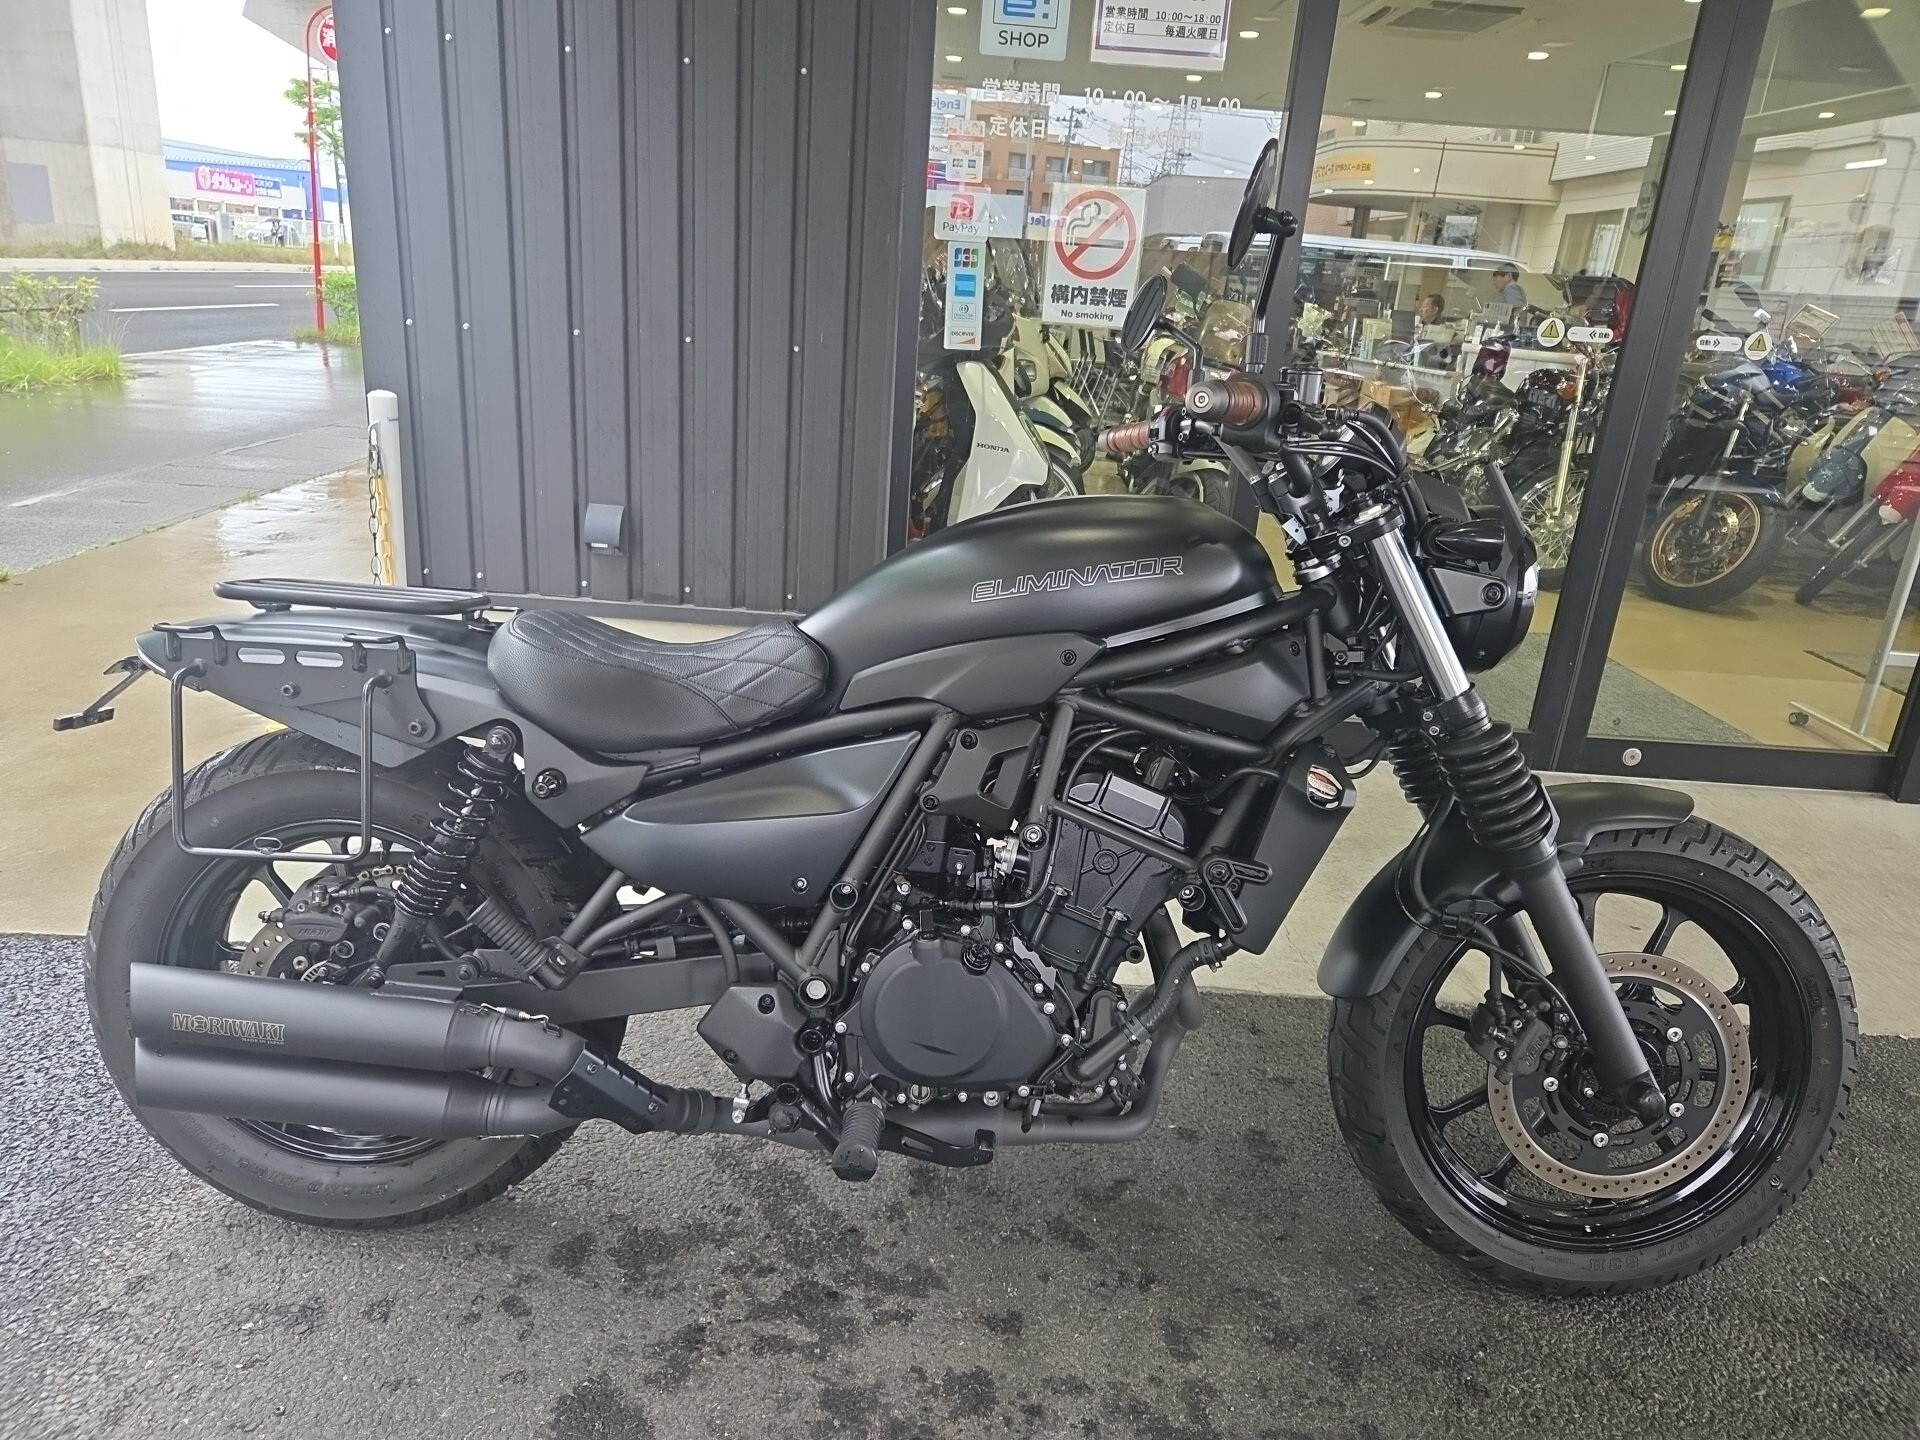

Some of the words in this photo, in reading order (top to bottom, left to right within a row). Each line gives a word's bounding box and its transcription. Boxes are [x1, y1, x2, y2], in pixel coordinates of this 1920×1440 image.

[1105, 5, 1149, 20] 営業時間
[998, 30, 1049, 48] SHOP
[1103, 21, 1135, 34] 定休日
[1165, 24, 1218, 39] 毎週火曜日
[982, 78, 1061, 105] 営業時間
[989, 116, 1046, 139] 定休日
[942, 221, 979, 235] PayPay
[1051, 284, 1128, 308] 構内禁煙
[1060, 309, 1073, 318] No
[1075, 311, 1114, 322] smoking
[976, 442, 1011, 454] HONDA
[971, 555, 1184, 603] ELIMINATOR
[172, 1012, 285, 1042] MORIWAKI
